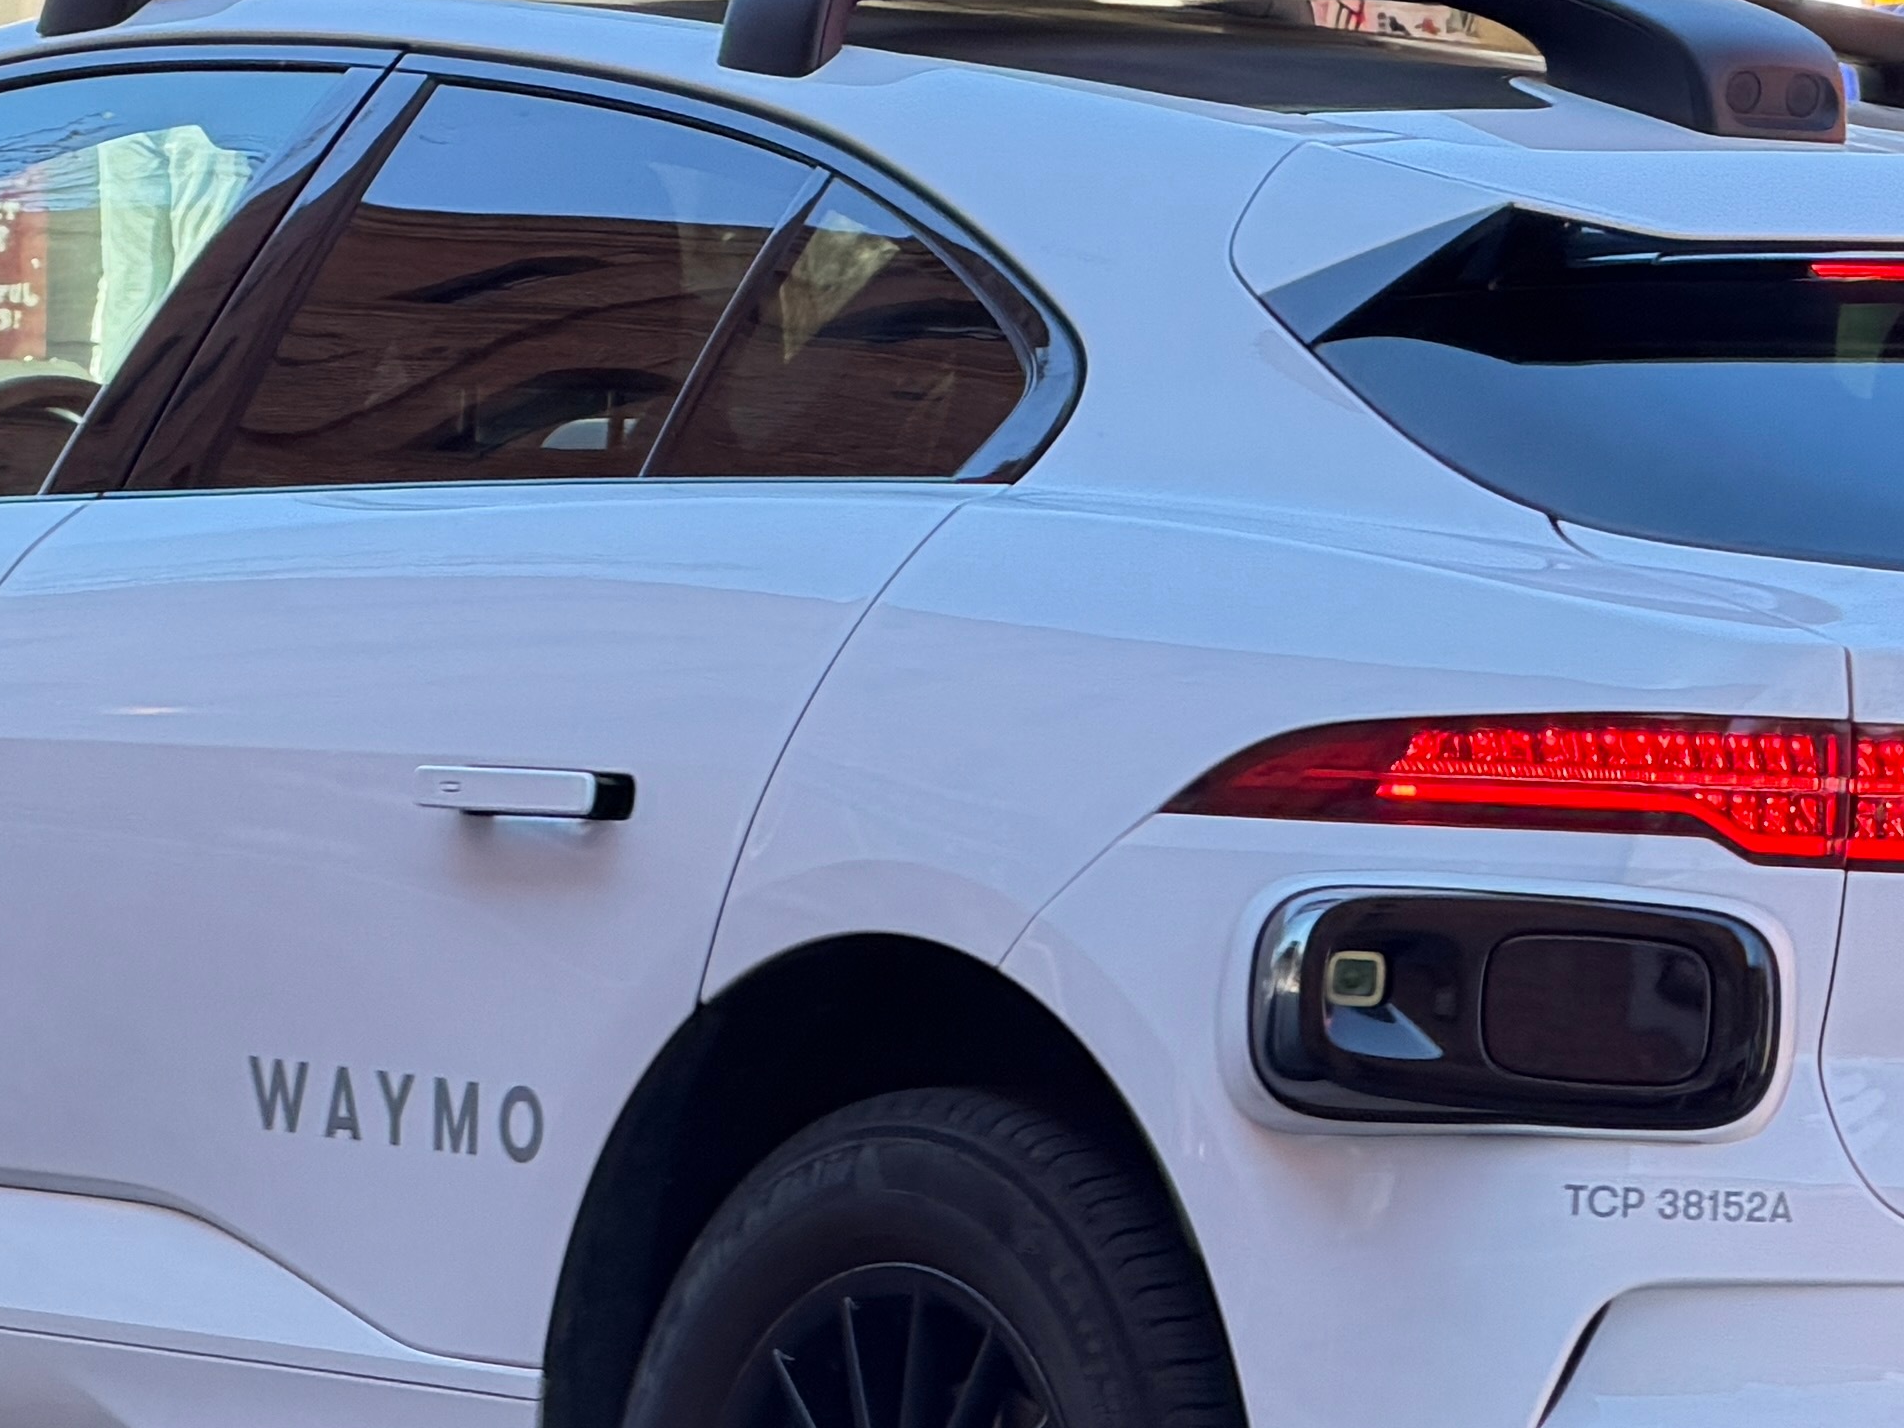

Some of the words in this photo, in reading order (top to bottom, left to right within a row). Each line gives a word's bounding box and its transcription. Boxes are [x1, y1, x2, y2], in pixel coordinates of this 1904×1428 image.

[247, 1054, 545, 1164] WAYMO
[1563, 1183, 1645, 1220] TCP
[1658, 1186, 1794, 1224] 38152A
